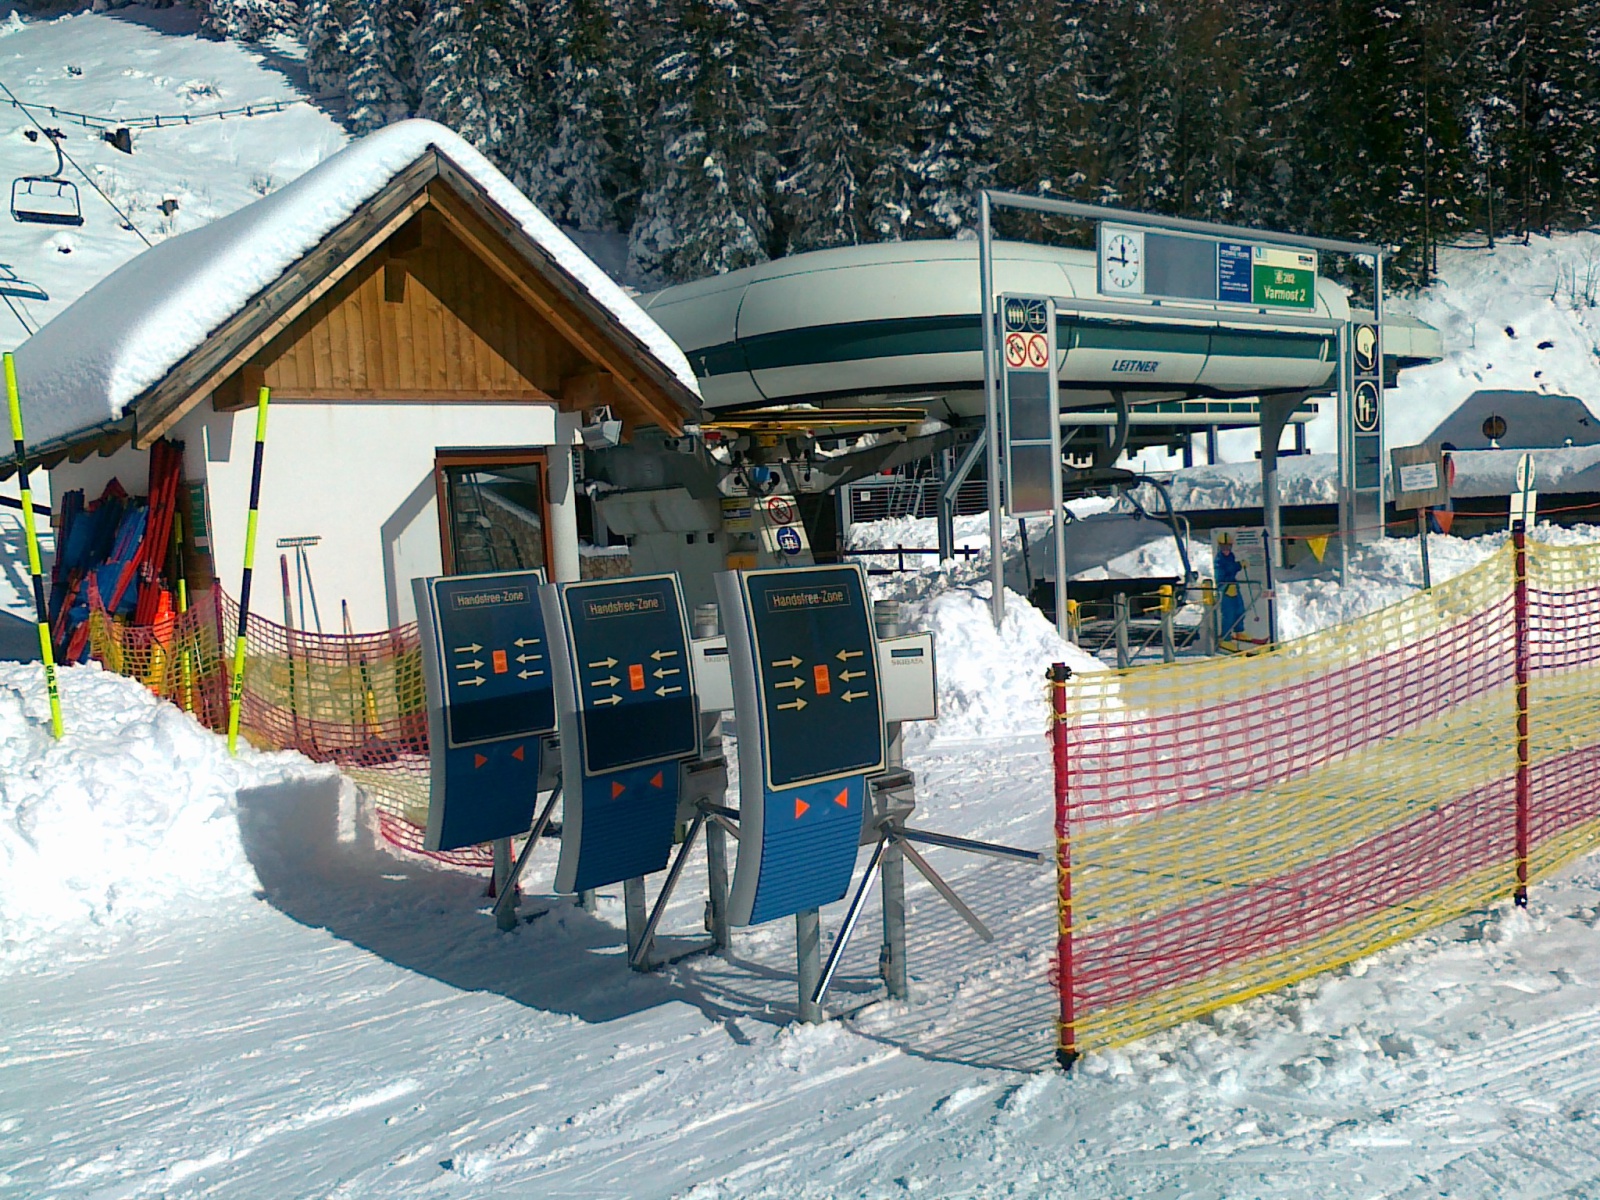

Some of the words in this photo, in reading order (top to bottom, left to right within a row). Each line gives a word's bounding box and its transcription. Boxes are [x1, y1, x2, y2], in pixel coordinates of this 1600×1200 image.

[1264, 285, 1298, 301] Varmost
[1299, 288, 1305, 301] 2
[1111, 359, 1159, 373] LEITNER
[456, 590, 524, 606] Handsfree-Zone
[772, 589, 844, 608] Handsfree-Zone
[589, 598, 659, 615] Handsfree-Zone
